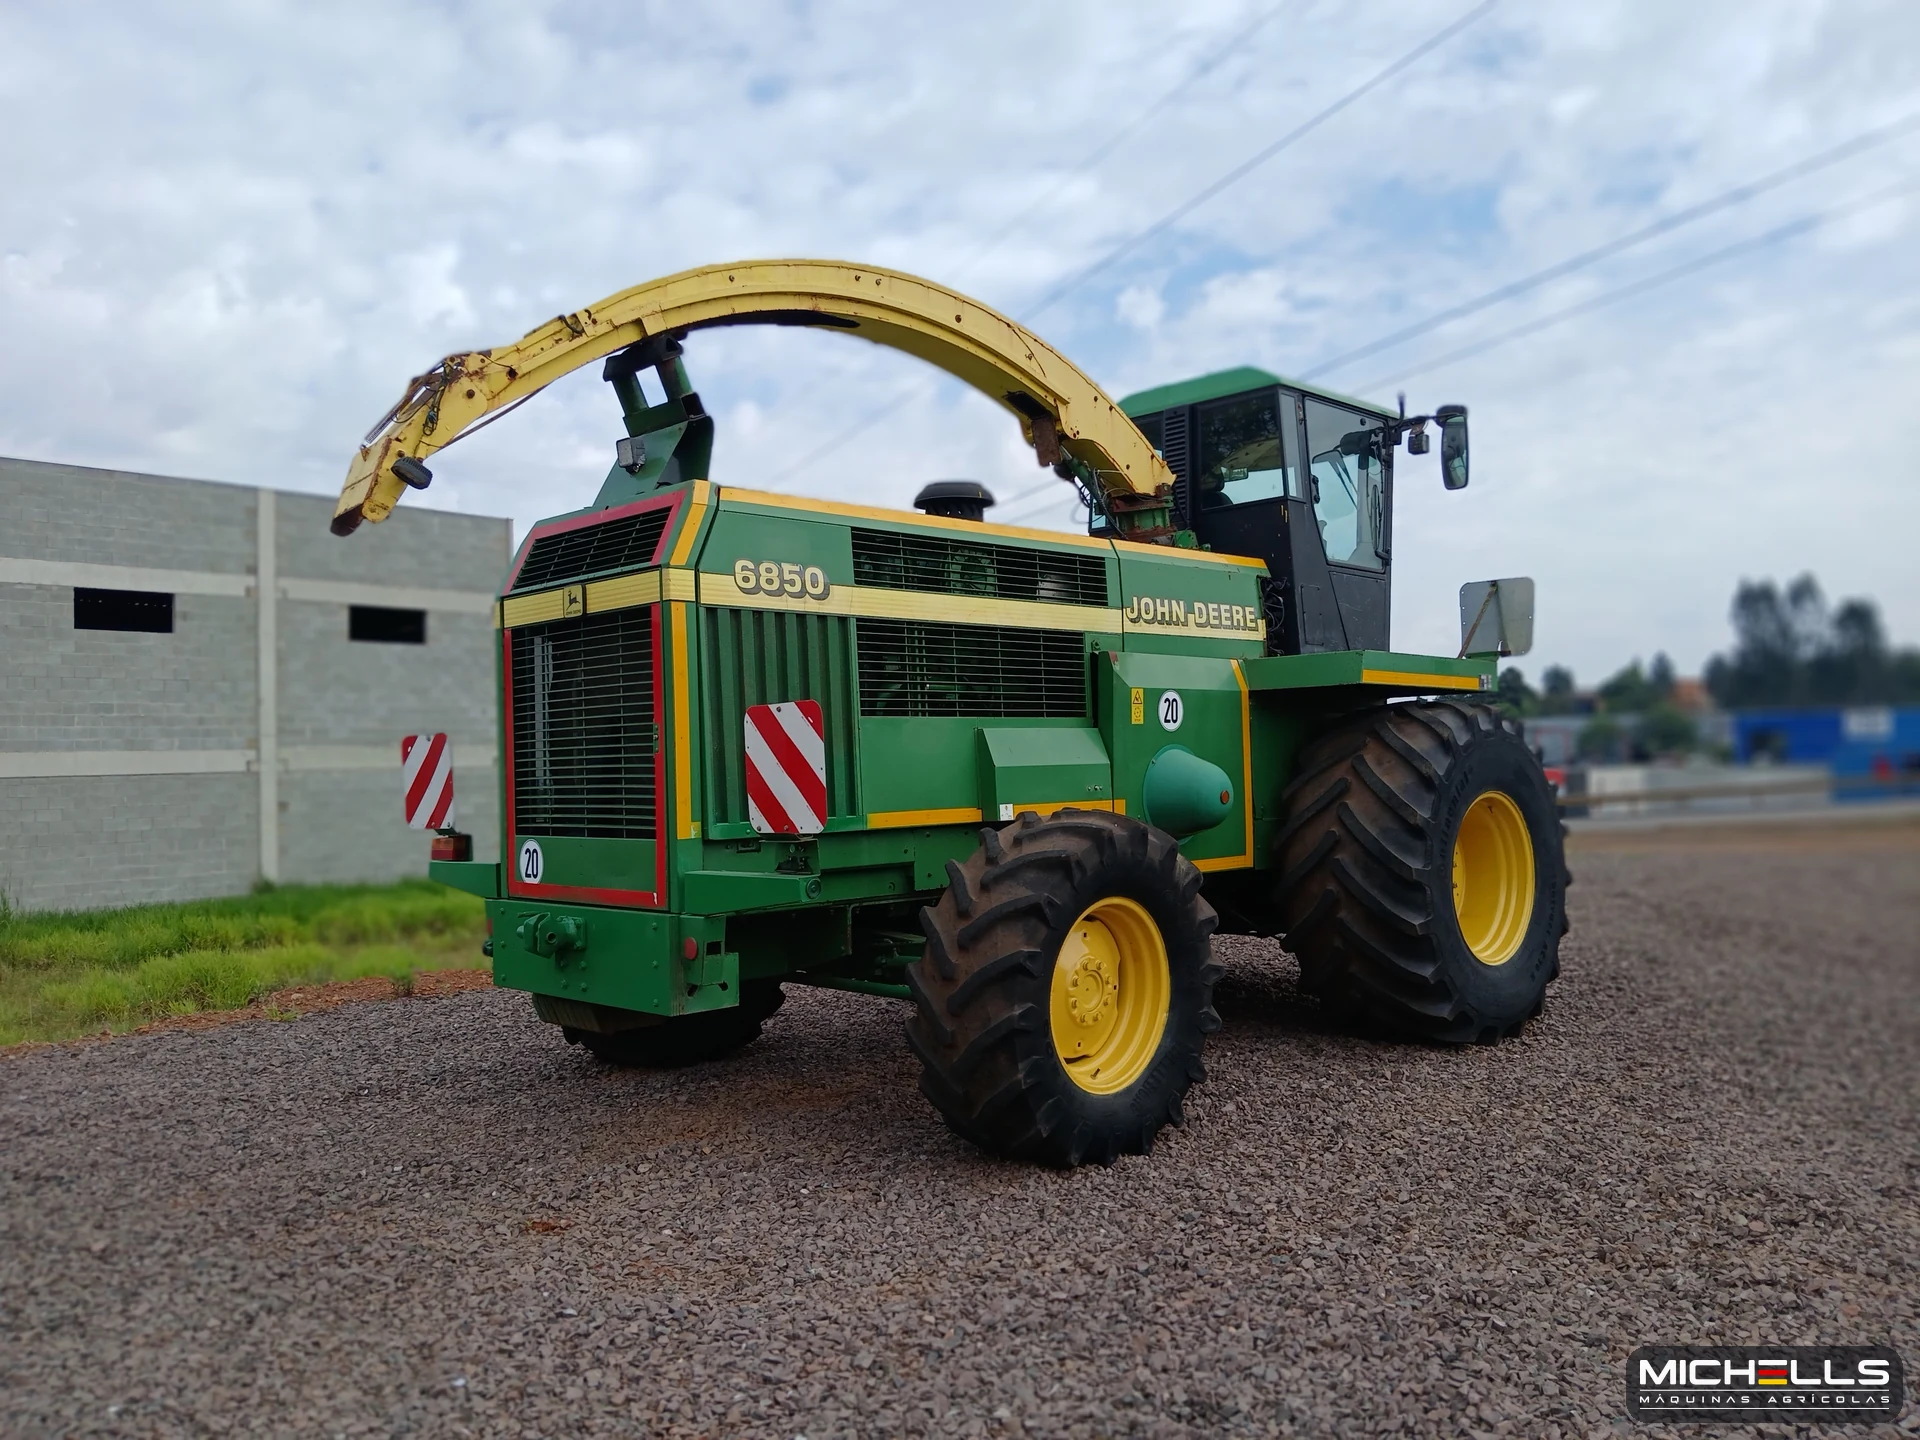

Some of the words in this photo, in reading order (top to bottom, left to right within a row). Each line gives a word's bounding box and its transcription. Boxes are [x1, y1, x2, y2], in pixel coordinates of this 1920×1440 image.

[734, 559, 829, 600] 6850
[1126, 596, 1187, 627] JOHN
[1194, 602, 1258, 631] DEERE
[1163, 697, 1178, 724] 20
[524, 847, 539, 879] 20
